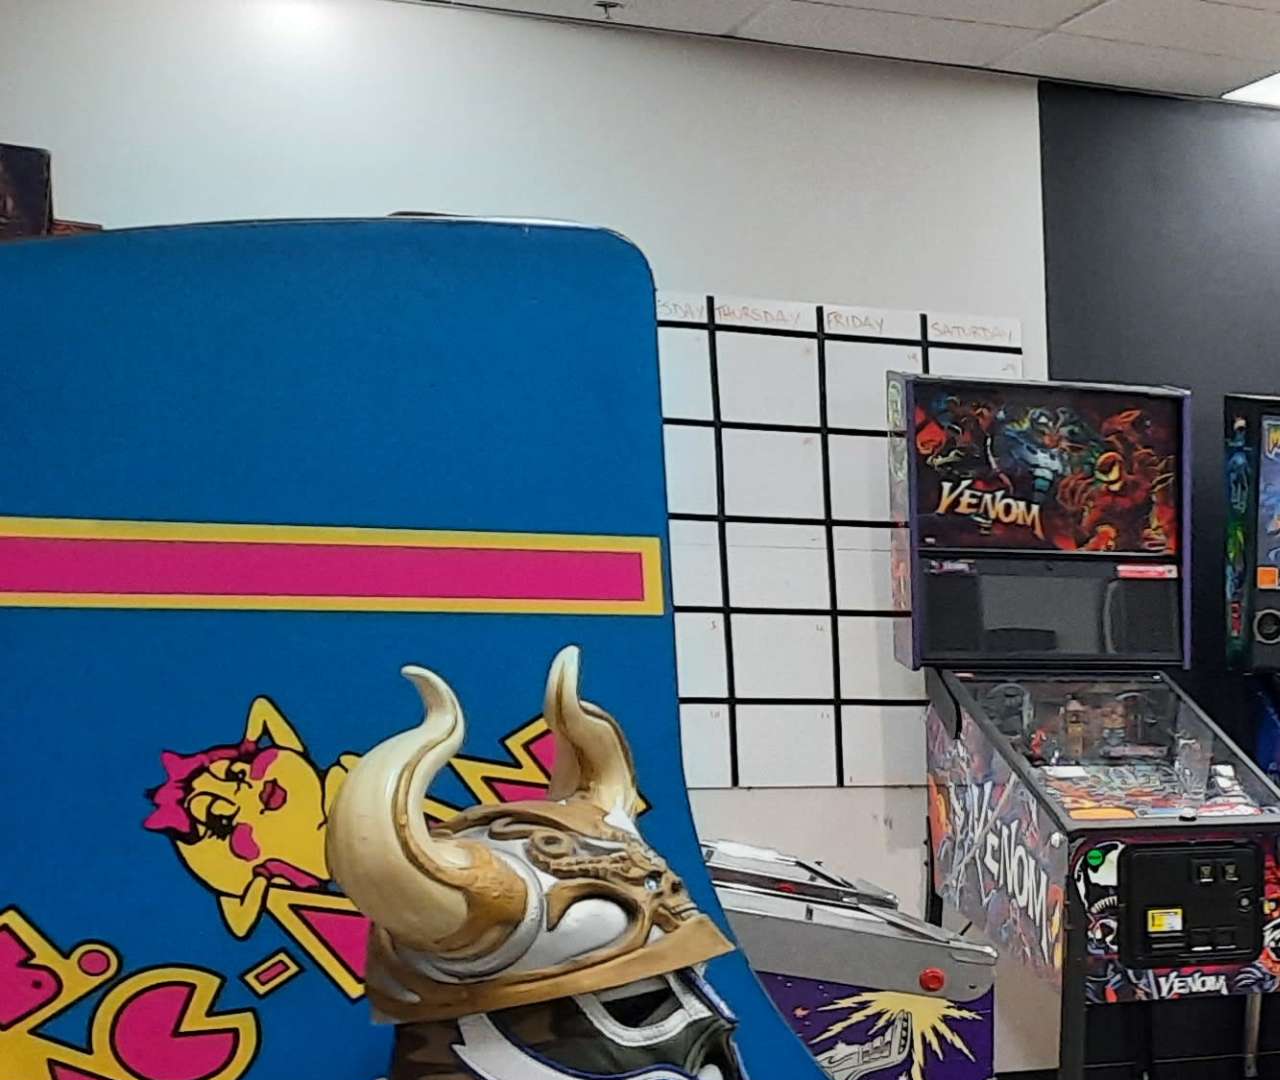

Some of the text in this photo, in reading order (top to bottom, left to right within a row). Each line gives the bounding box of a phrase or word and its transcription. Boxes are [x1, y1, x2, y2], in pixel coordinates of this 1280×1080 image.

[715, 304, 802, 326] THURSDAY
[827, 311, 884, 333] FRIDAY
[931, 321, 1013, 342] SATURDAY
[935, 479, 1045, 540] VENOM
[1158, 971, 1230, 1000] VENOM
